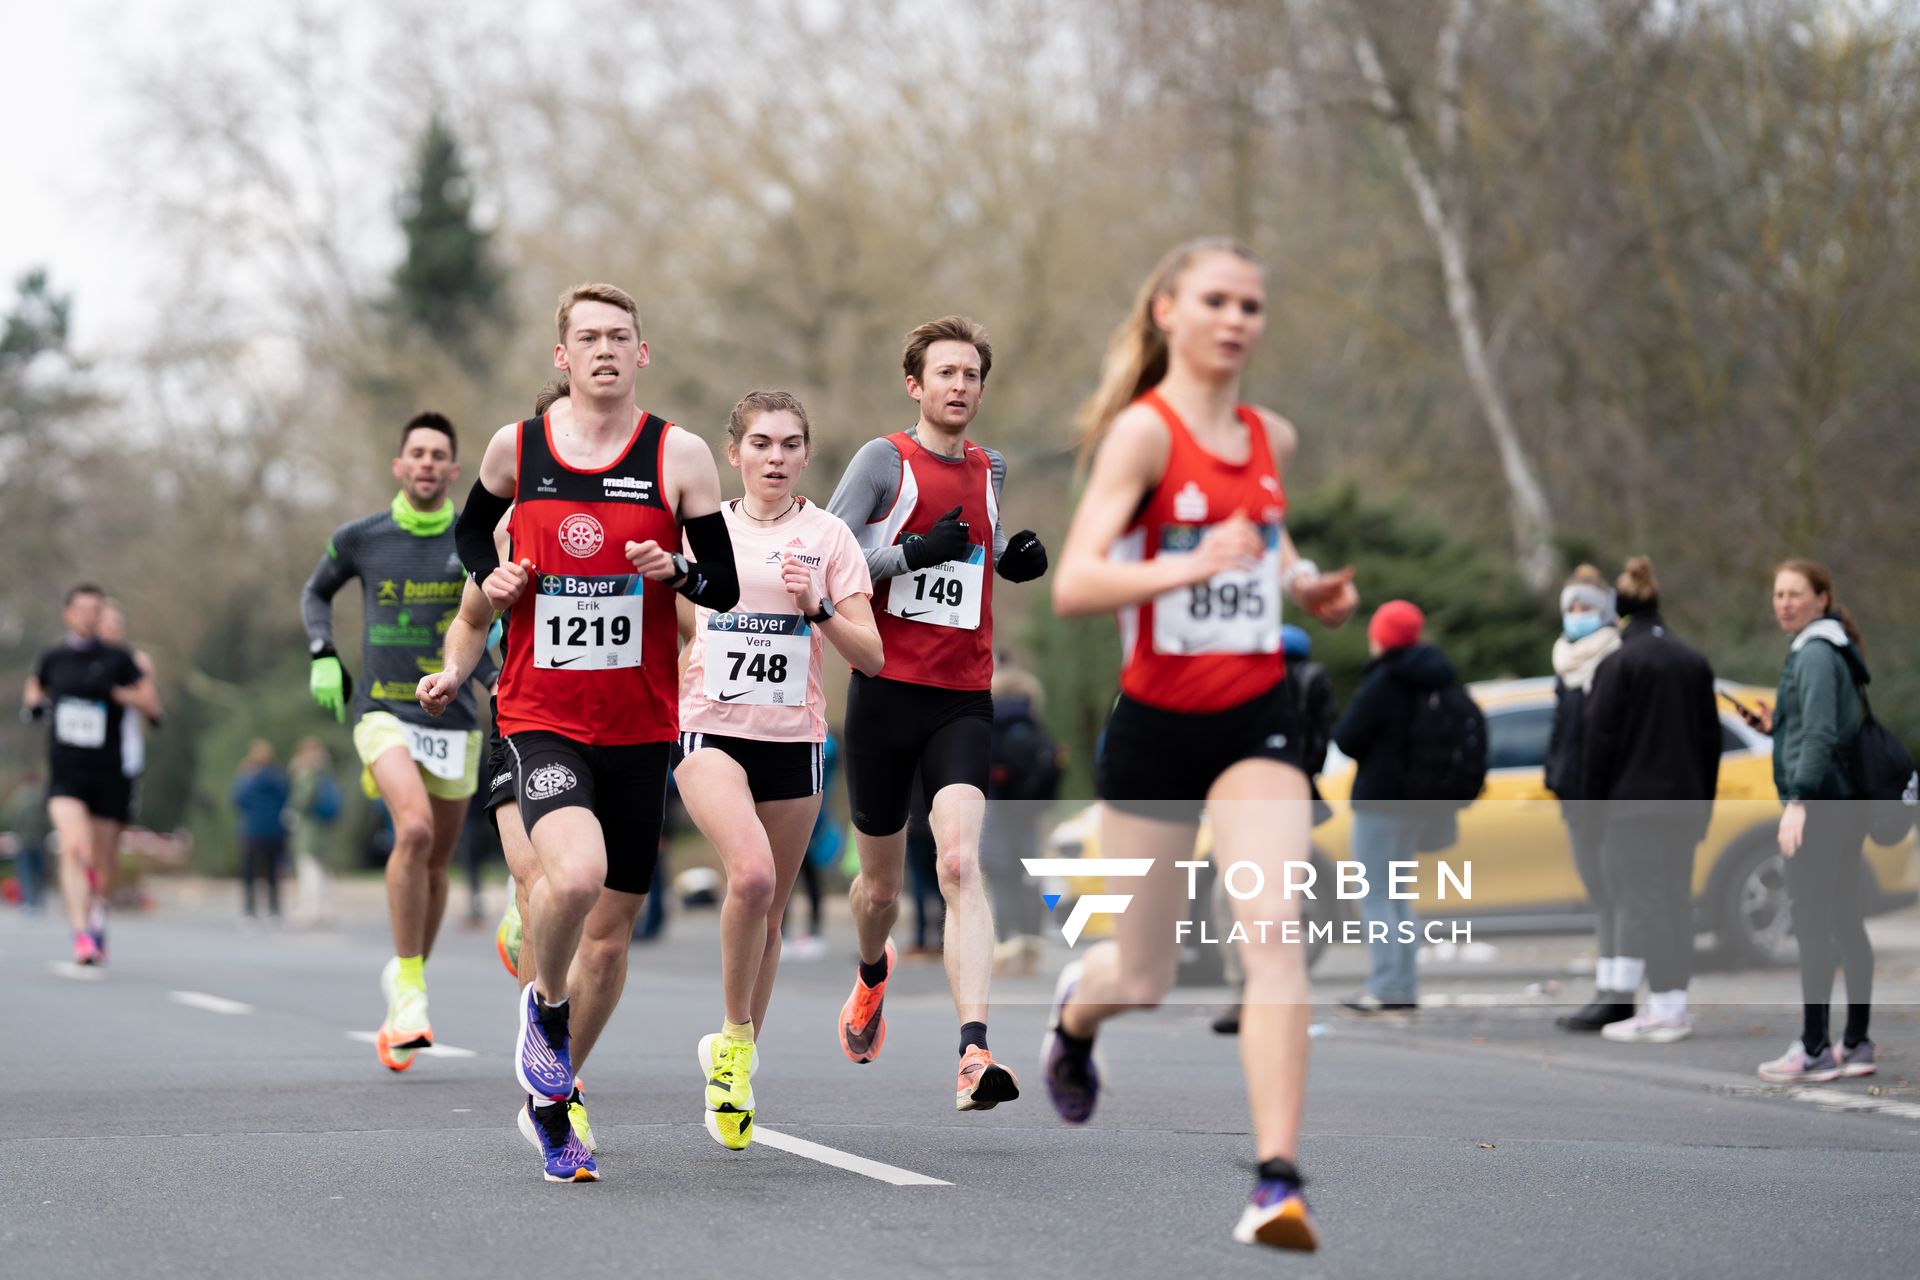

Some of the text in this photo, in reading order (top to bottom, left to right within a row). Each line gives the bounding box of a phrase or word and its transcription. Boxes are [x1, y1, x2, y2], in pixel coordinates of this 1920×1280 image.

[793, 554, 821, 567] nert
[930, 562, 955, 573] artin
[565, 577, 616, 597] Bayer
[913, 573, 963, 607] 149
[577, 601, 600, 611] Erik
[1190, 580, 1265, 620] 895
[546, 616, 631, 646] 1219
[737, 614, 786, 633] Bayer
[745, 636, 772, 647] Vera
[727, 651, 788, 683] 748
